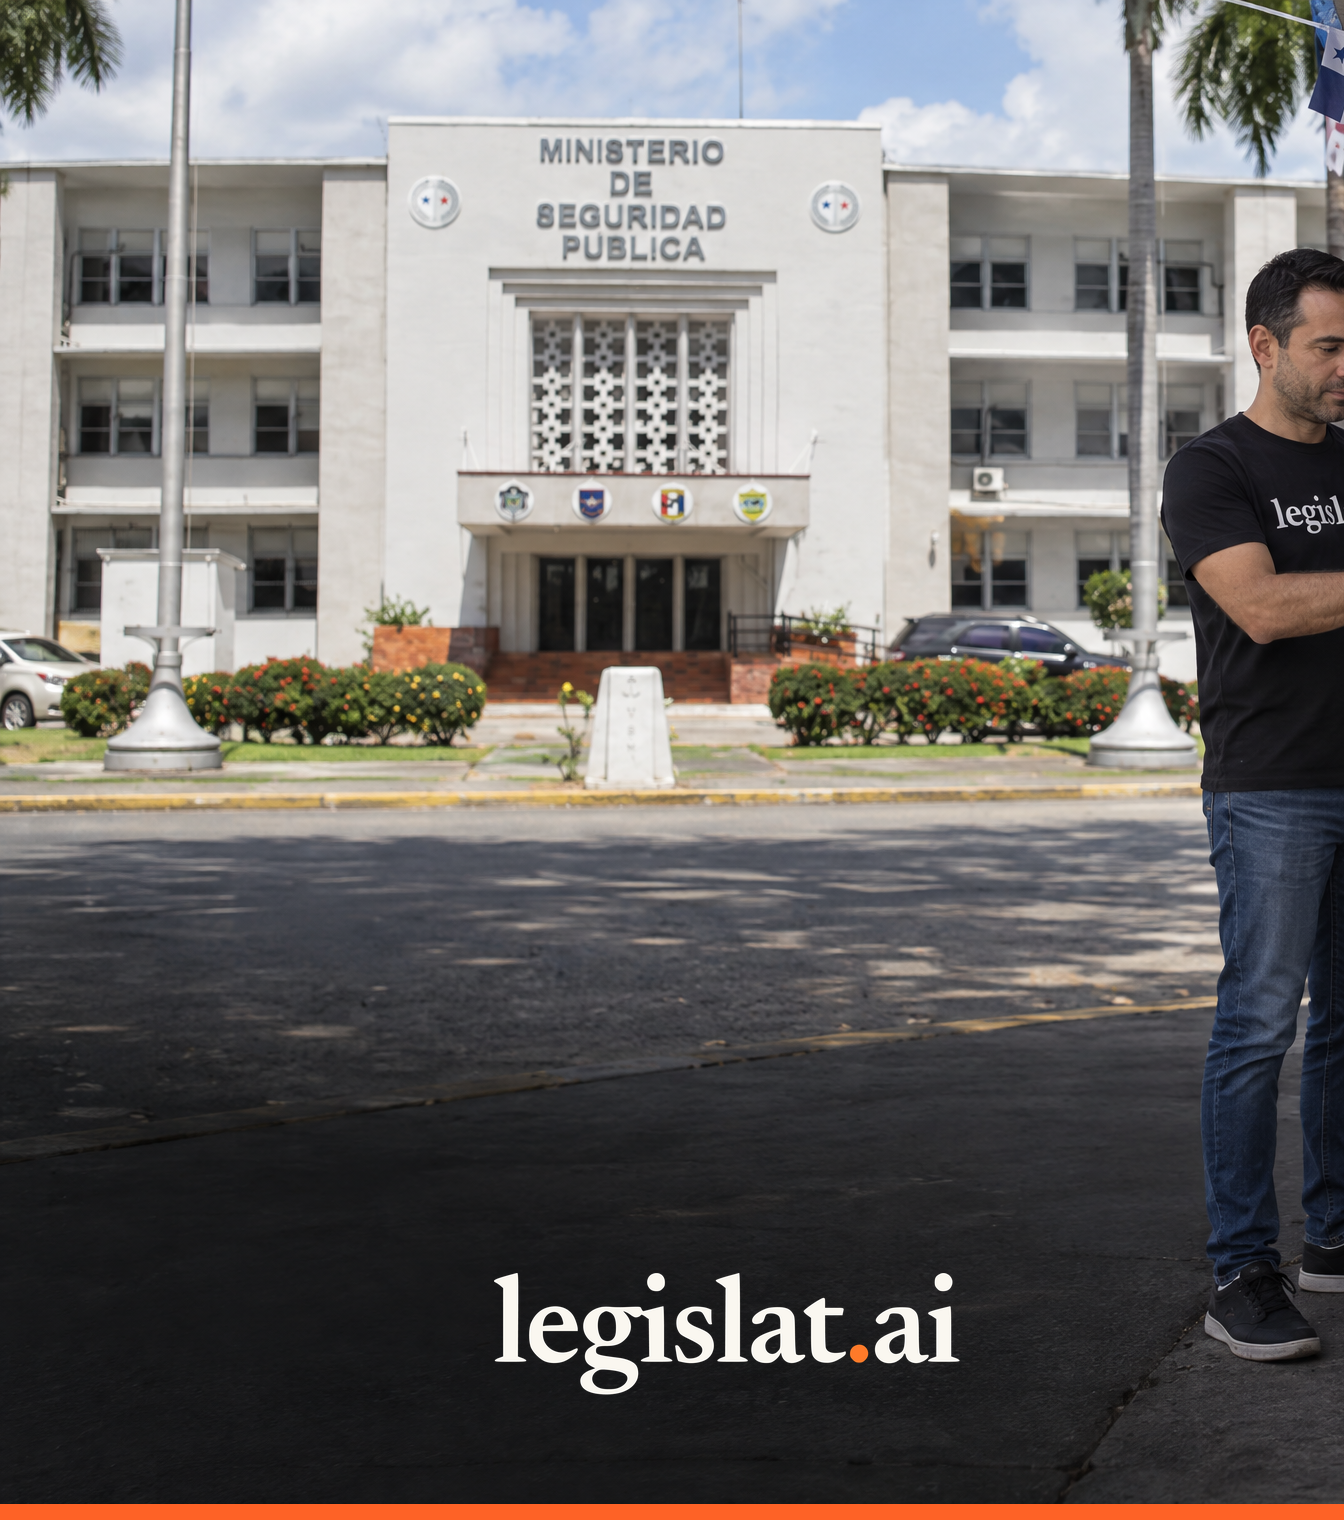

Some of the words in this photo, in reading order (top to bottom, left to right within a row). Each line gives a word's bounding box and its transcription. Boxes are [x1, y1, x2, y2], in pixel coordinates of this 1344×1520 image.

[540, 138, 724, 167] MINISTERIO
[610, 171, 653, 198] DE
[536, 203, 726, 231] SEGURIDAD
[562, 235, 706, 262] PUBLICA
